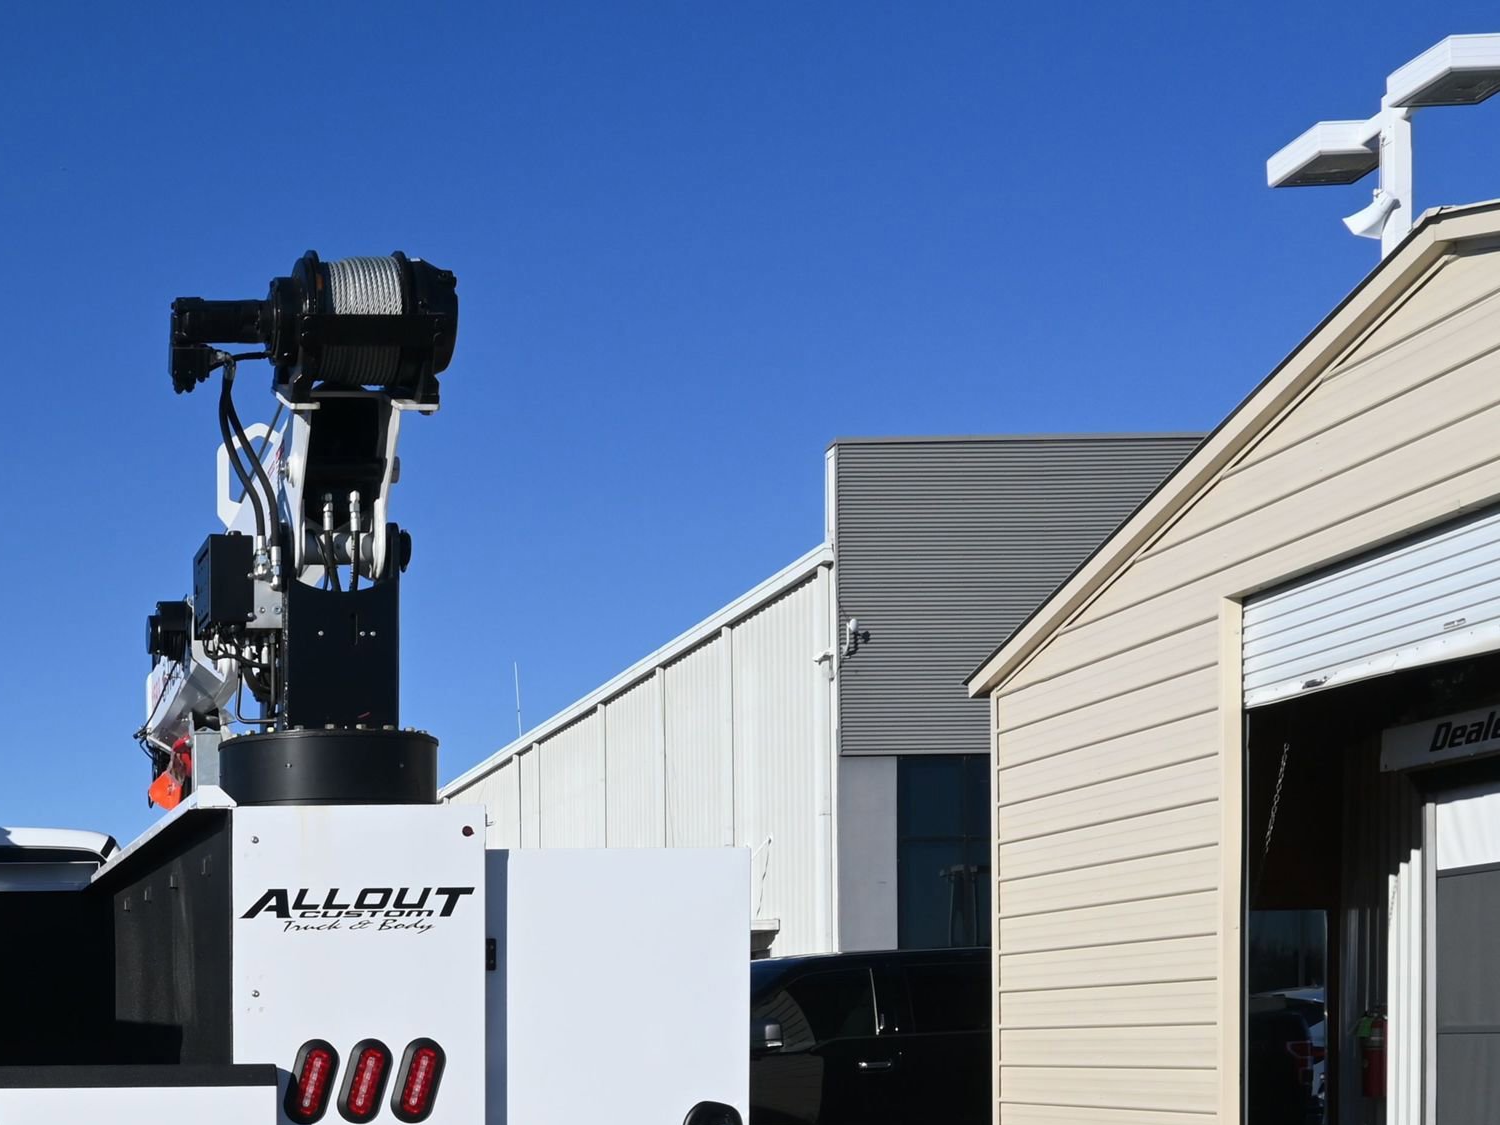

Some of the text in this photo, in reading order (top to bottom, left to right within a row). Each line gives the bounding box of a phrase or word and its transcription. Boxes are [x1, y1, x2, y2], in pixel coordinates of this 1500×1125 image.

[239, 887, 475, 919] ALLOUT
[283, 918, 437, 934] Truck & Body
